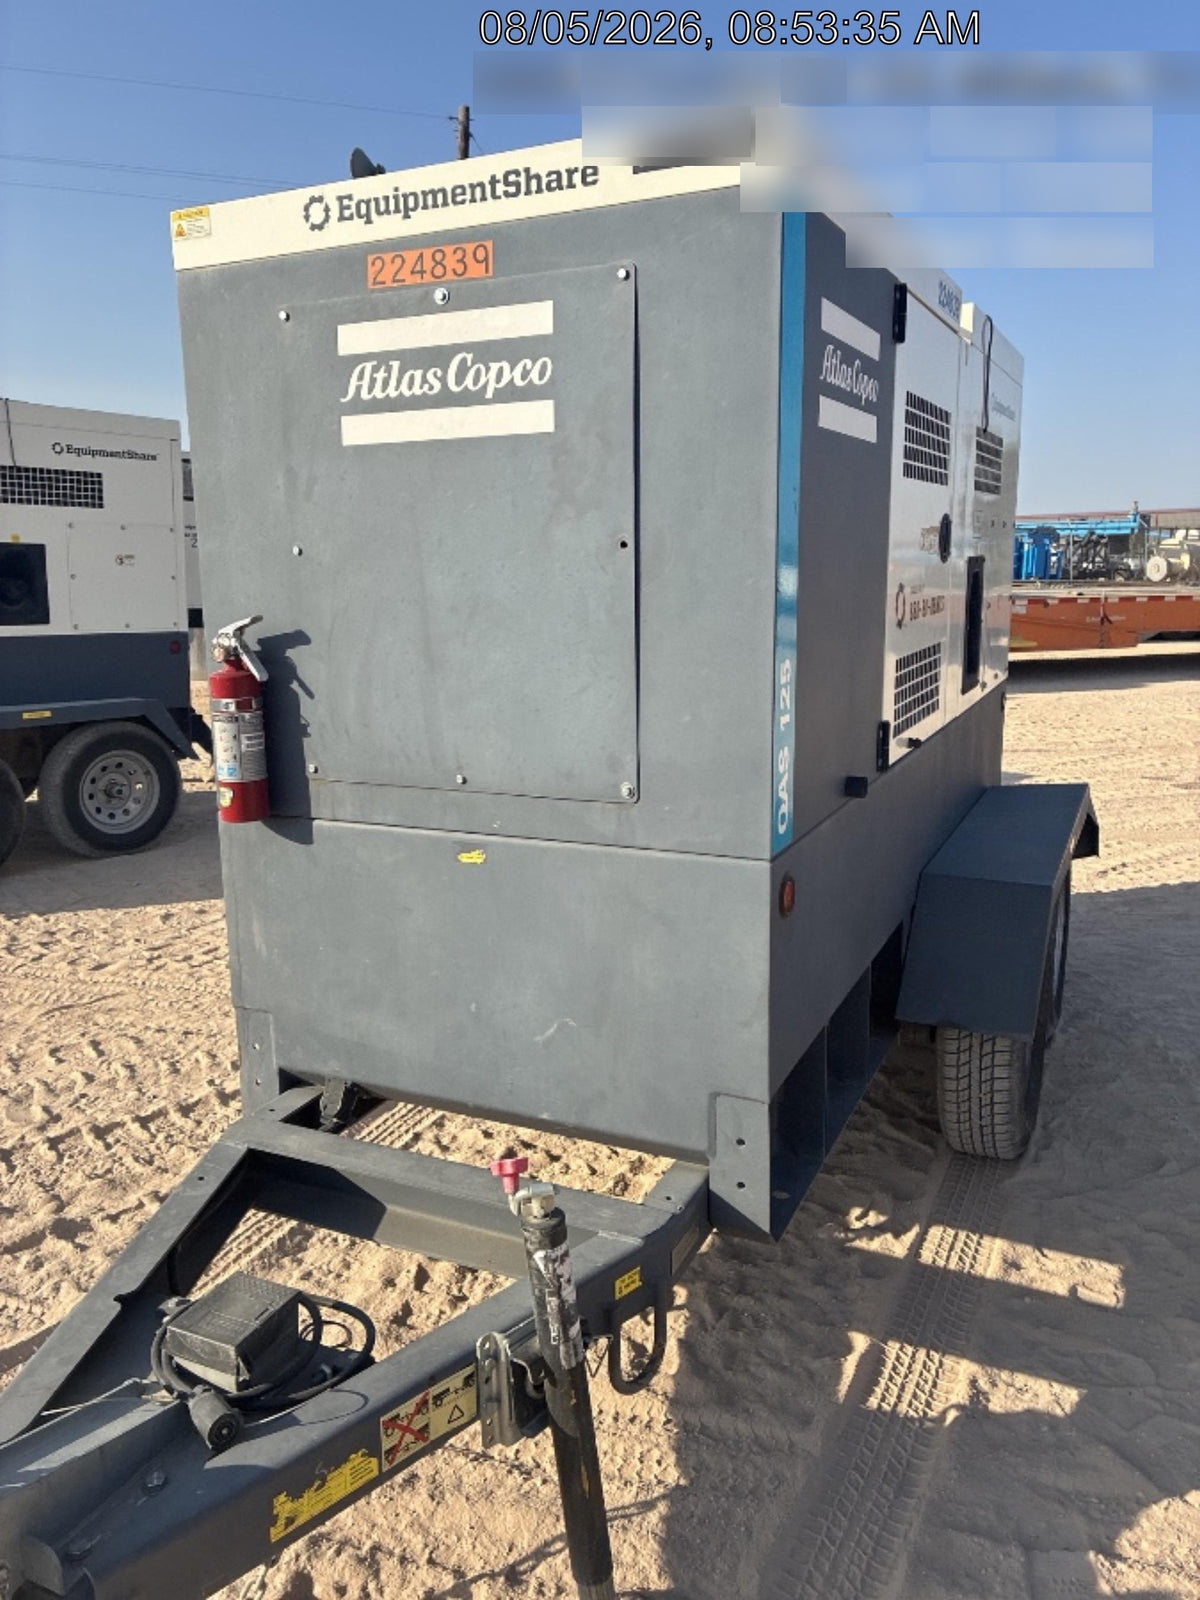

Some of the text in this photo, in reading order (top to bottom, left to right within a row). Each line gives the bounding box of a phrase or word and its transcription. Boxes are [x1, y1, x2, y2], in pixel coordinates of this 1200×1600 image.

[336, 165, 599, 225] EquipmentShare
[370, 243, 490, 286] 224839
[340, 352, 553, 402] Atlas Copco
[819, 344, 879, 406] Atlas Copco
[65, 444, 157, 461] EquipmentShare
[778, 658, 791, 834] QAS 125
